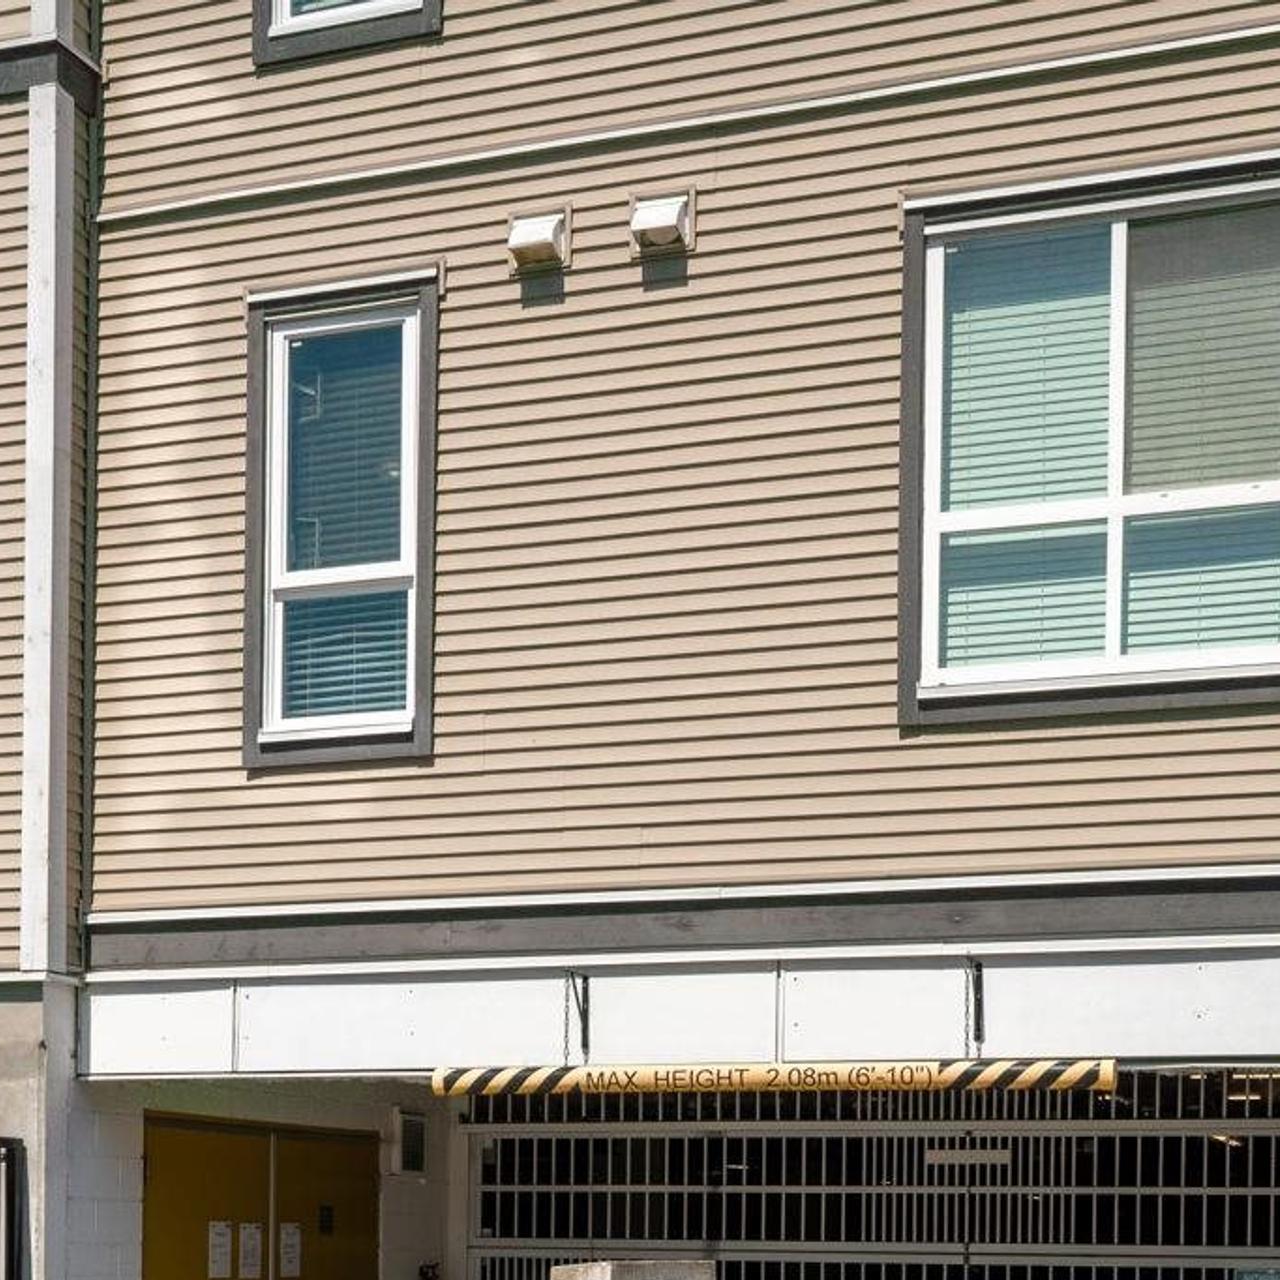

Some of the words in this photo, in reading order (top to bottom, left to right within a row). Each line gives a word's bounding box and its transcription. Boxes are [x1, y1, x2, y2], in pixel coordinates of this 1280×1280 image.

[585, 1070, 638, 1090] MAX
[654, 1068, 750, 1089] HEIGHT
[766, 1067, 839, 1087] 2.08m
